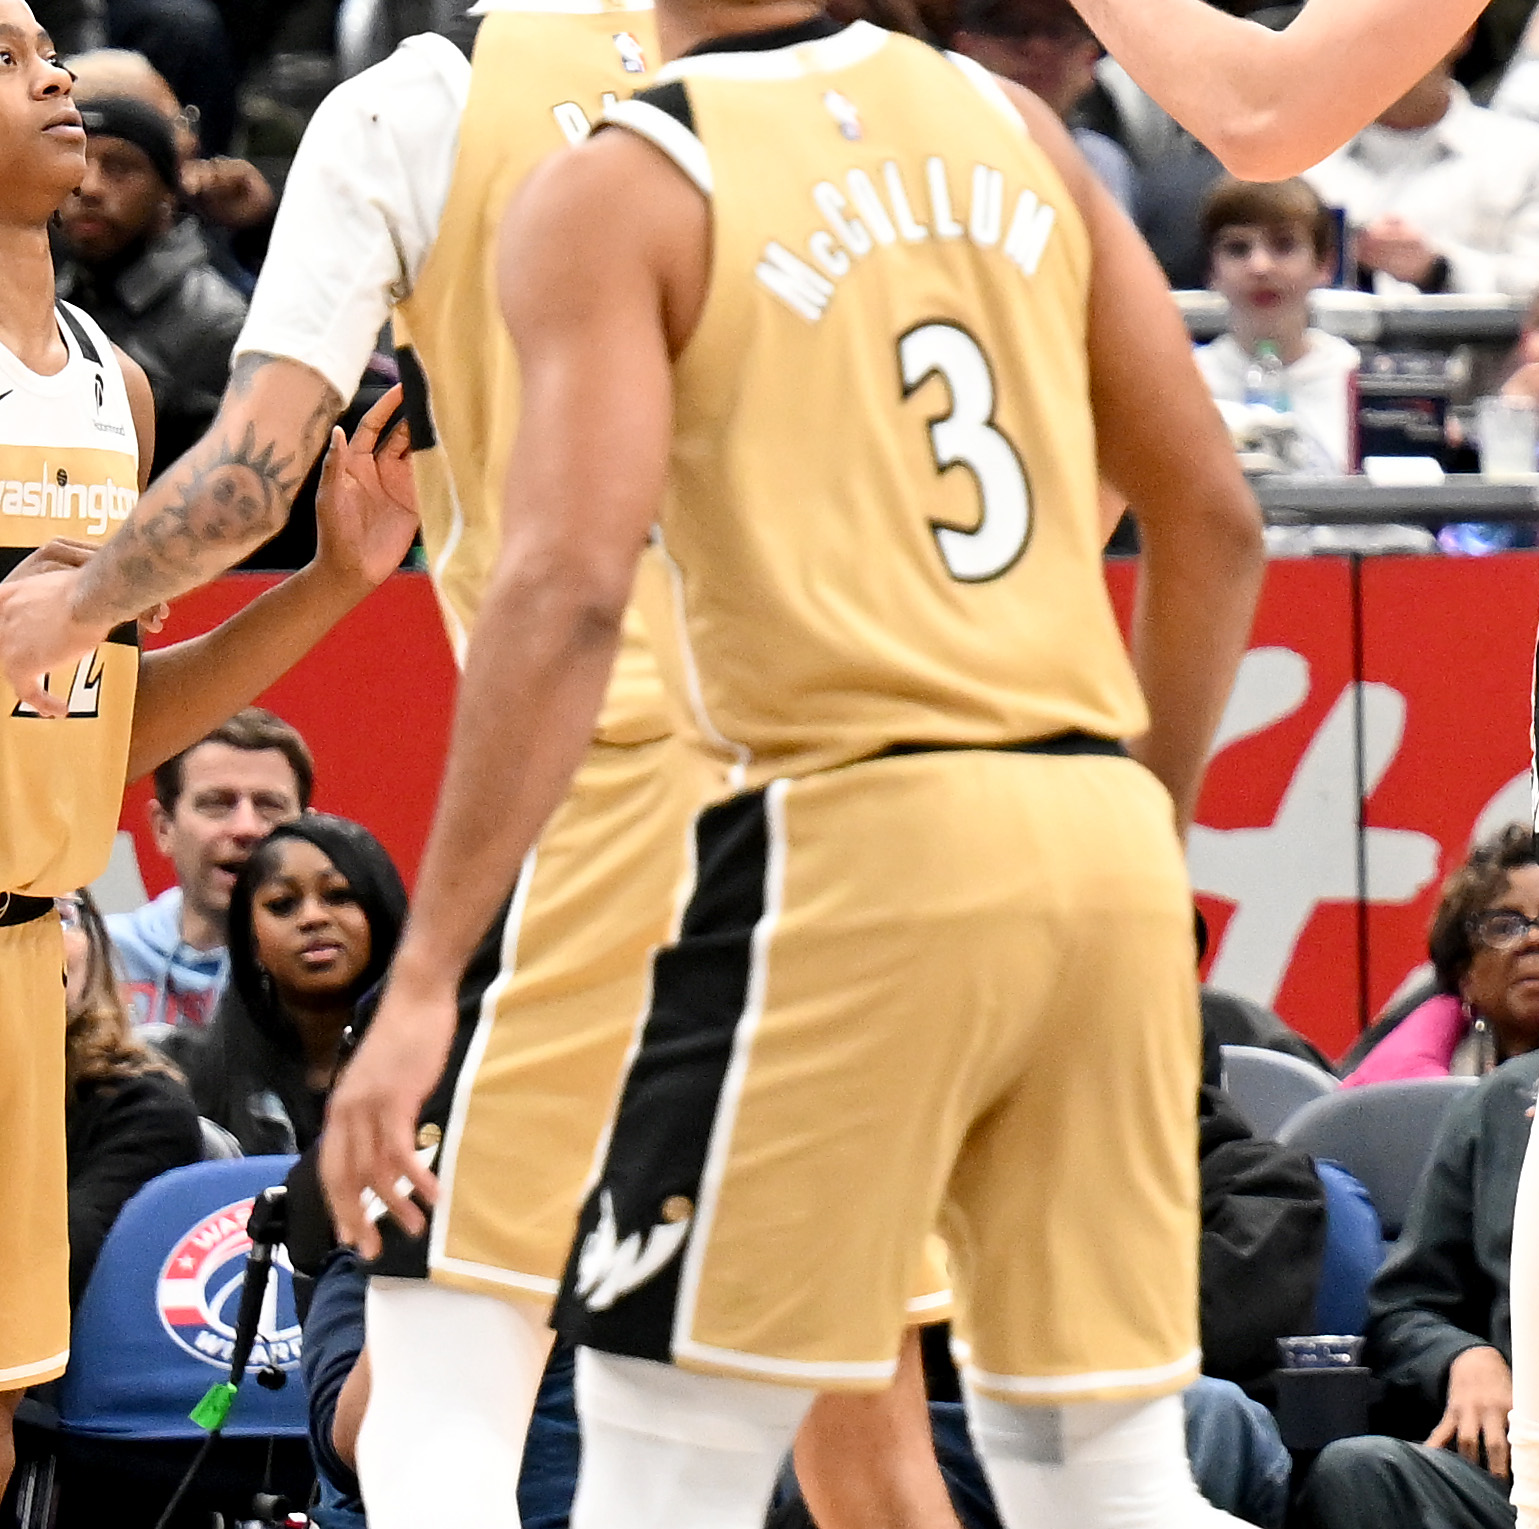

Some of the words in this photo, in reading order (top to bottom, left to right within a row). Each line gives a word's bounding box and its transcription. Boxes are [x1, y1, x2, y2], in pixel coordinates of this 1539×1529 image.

[755, 157, 1056, 323] McCOLLUM
[0, 460, 137, 535] ashington
[896, 318, 1034, 585] 3
